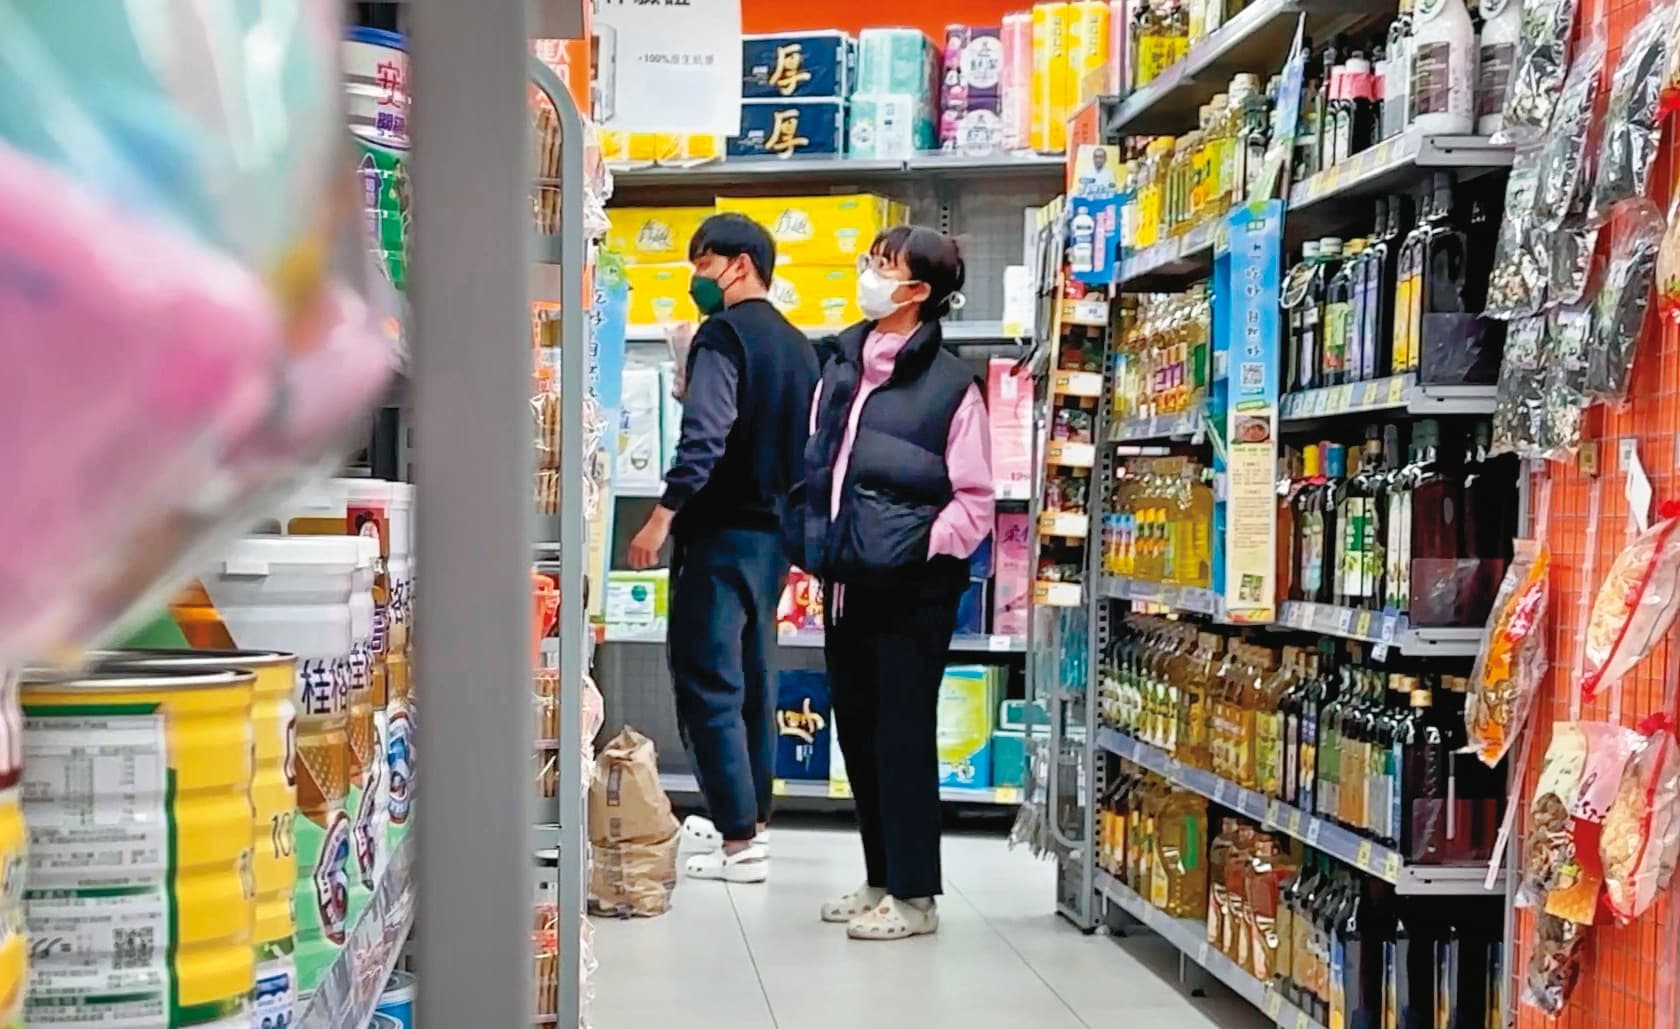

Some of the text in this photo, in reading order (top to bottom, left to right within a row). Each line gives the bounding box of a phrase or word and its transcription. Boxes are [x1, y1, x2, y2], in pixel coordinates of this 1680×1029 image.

[768, 43, 811, 95] 厚
[764, 108, 809, 158] 厚
[300, 658, 348, 716] 桂格
